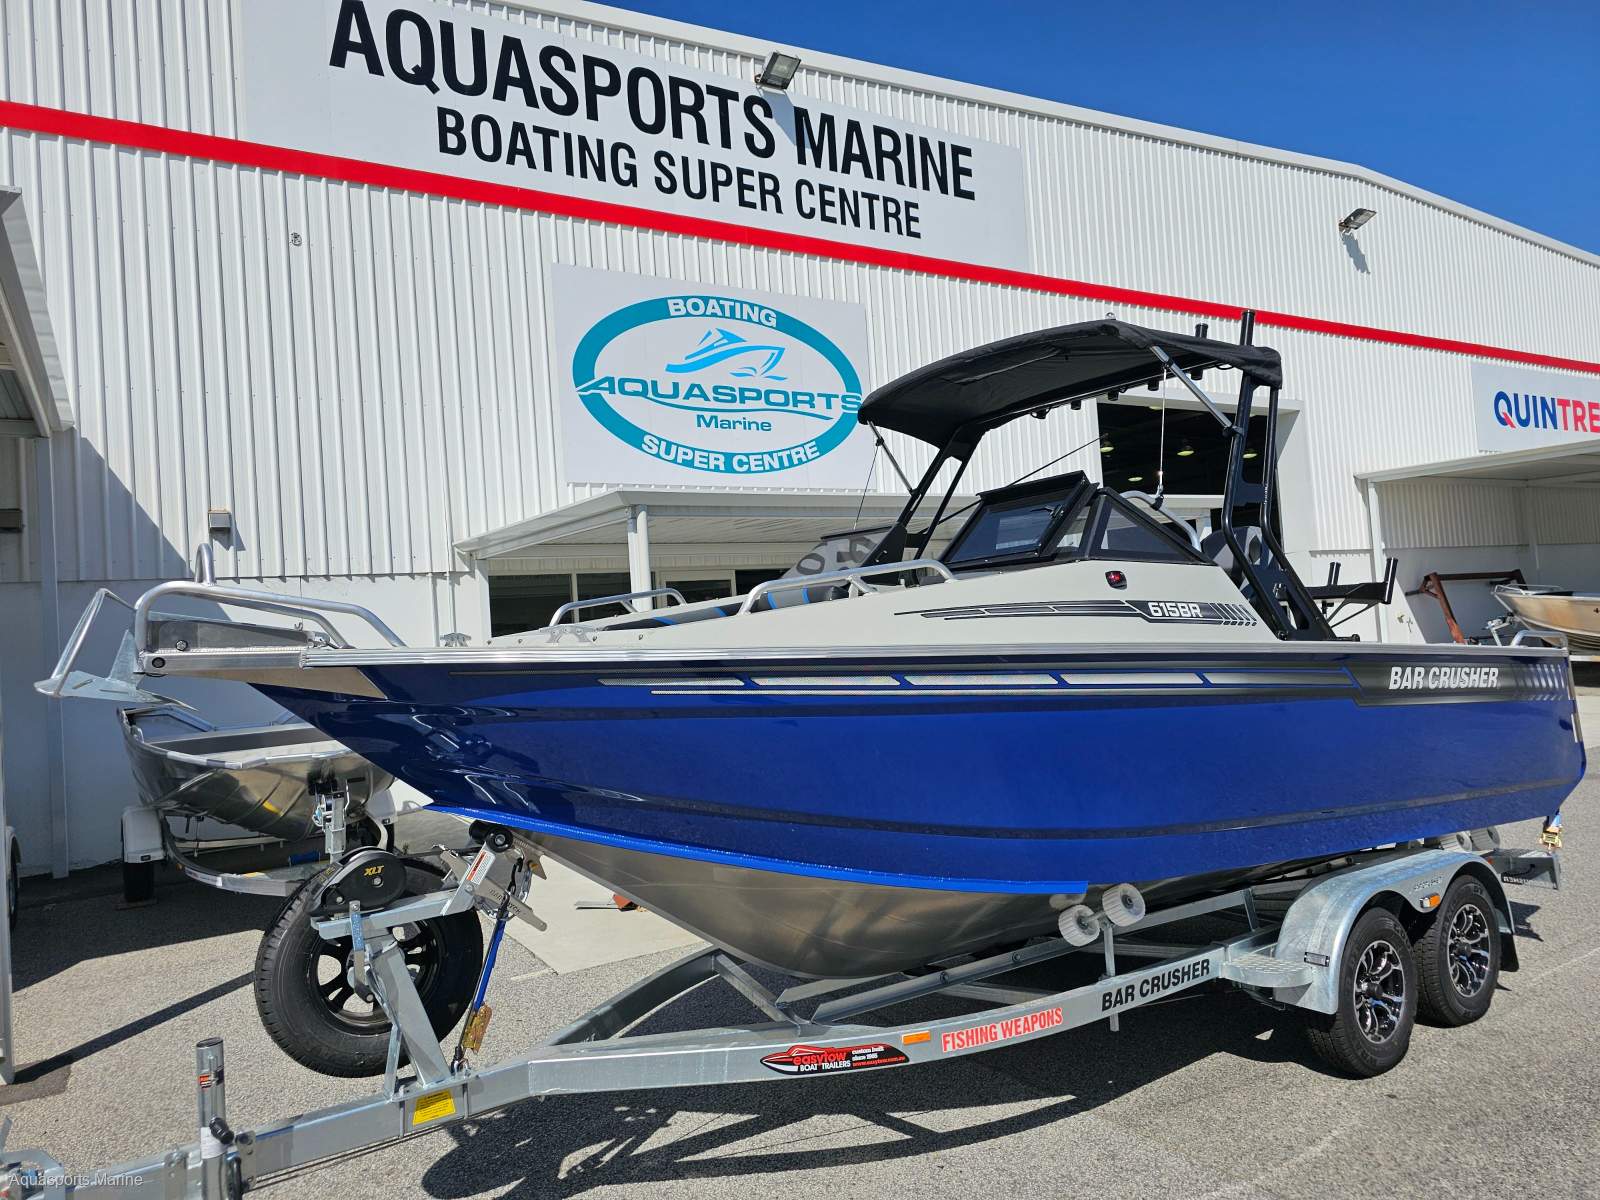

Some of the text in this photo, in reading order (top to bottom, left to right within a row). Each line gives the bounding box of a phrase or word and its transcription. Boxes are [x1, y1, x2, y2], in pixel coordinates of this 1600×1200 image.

[329, 0, 975, 200] AQUASPORTS MARINE
[438, 107, 921, 239] BOATING SUPER CENTRE
[667, 297, 777, 328] BOATING
[576, 376, 862, 413] AQUASPORTS
[696, 414, 772, 432] Marine
[641, 434, 820, 472] SUPER CENTRE
[1148, 601, 1202, 618] 615BR
[1388, 666, 1499, 690] BAR CRUSHER
[363, 865, 385, 876] XLT
[1102, 958, 1210, 1012] BAR CRUSHER
[942, 1008, 1063, 1052] FISHING WEAPONS
[793, 1050, 847, 1066] easytow
[800, 1060, 851, 1072] BOAT TRAILERS
